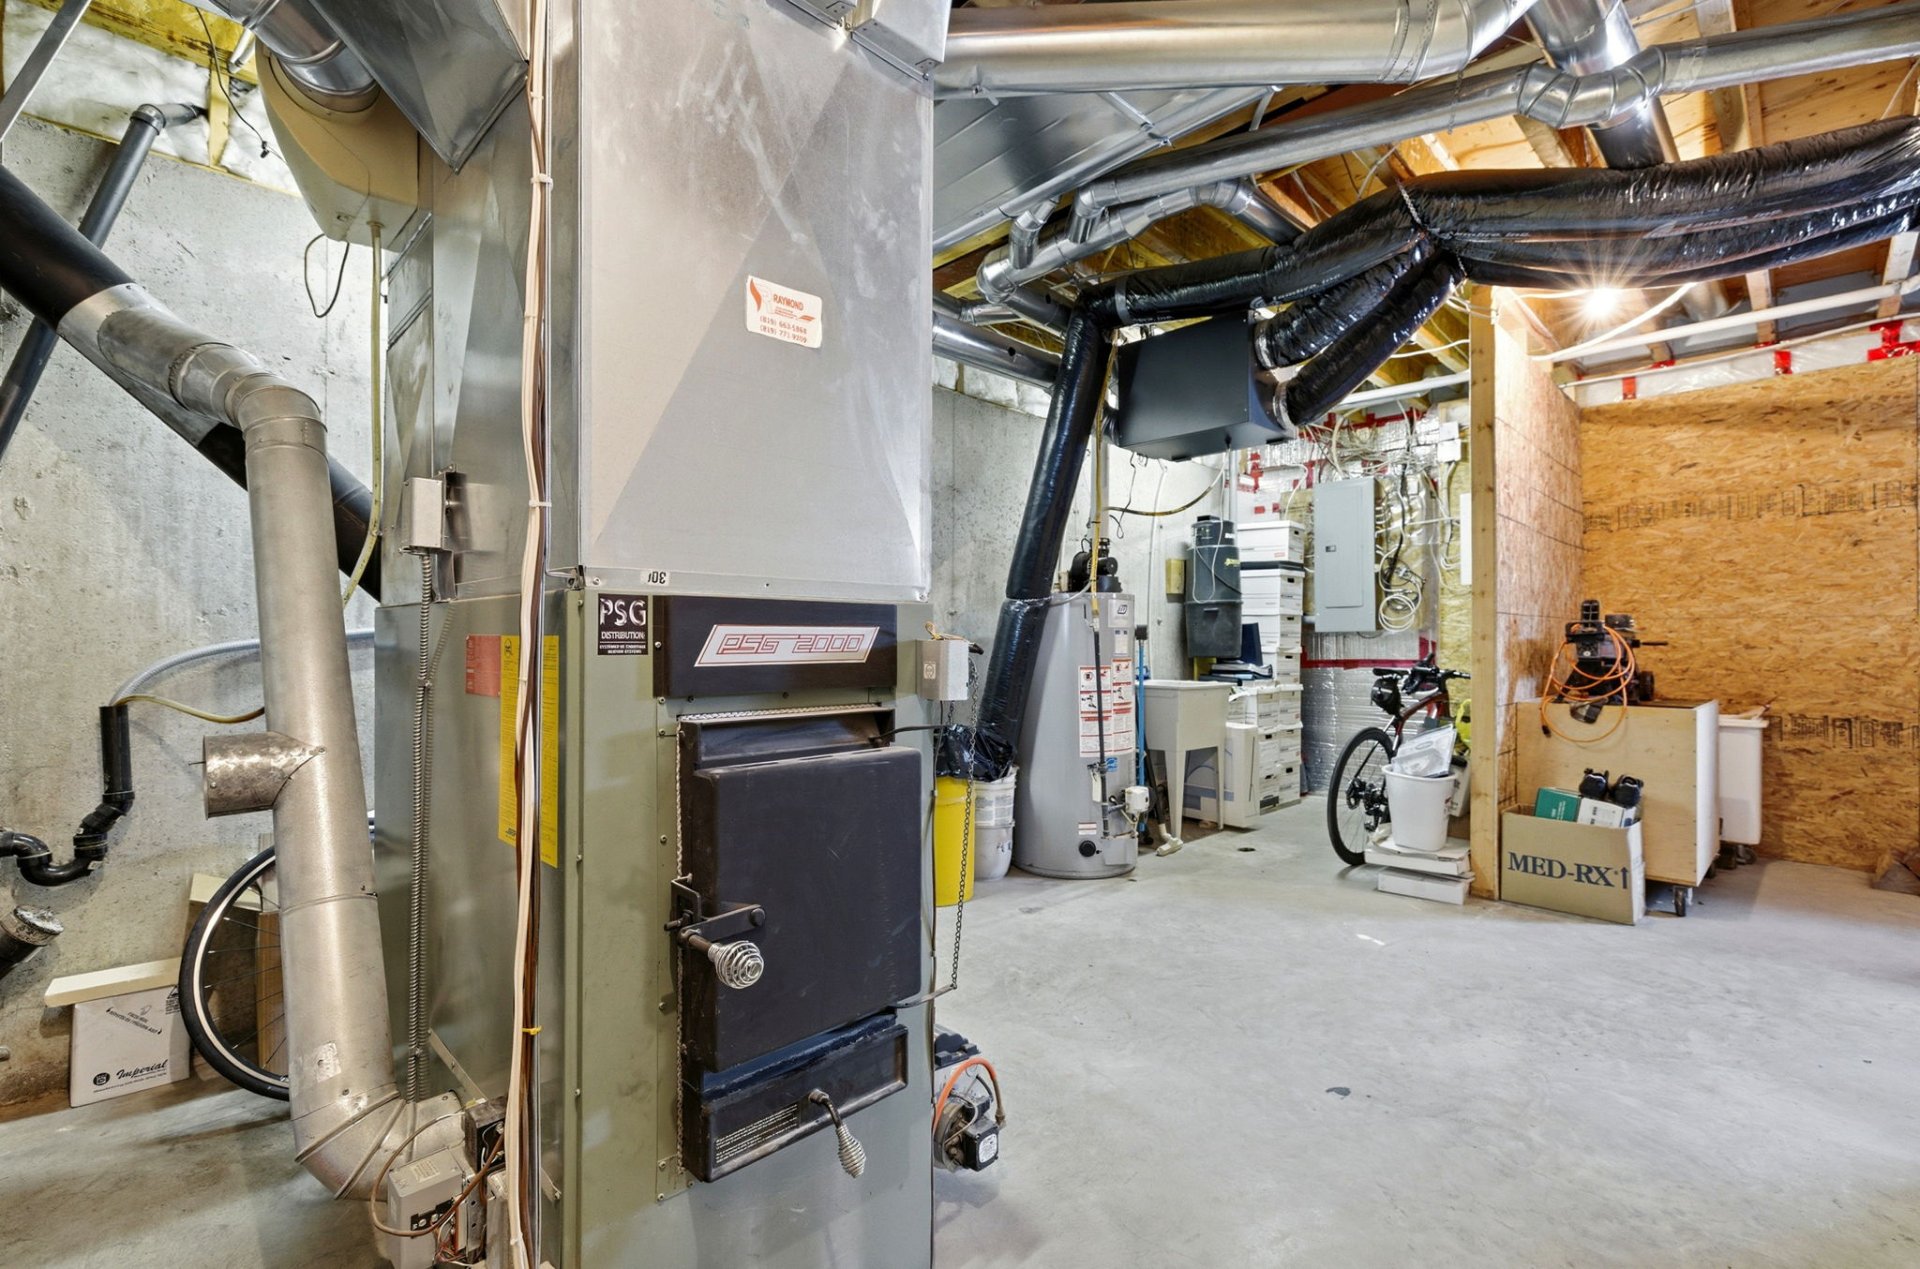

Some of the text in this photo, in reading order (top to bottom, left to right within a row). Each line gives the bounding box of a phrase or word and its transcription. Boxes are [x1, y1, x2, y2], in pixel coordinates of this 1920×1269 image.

[773, 294, 804, 311] RAYMOND
[600, 598, 646, 627] PSG
[716, 634, 865, 655] PSG 2000
[1507, 851, 1615, 888] MED-RX
[116, 1059, 169, 1080] Imperial
